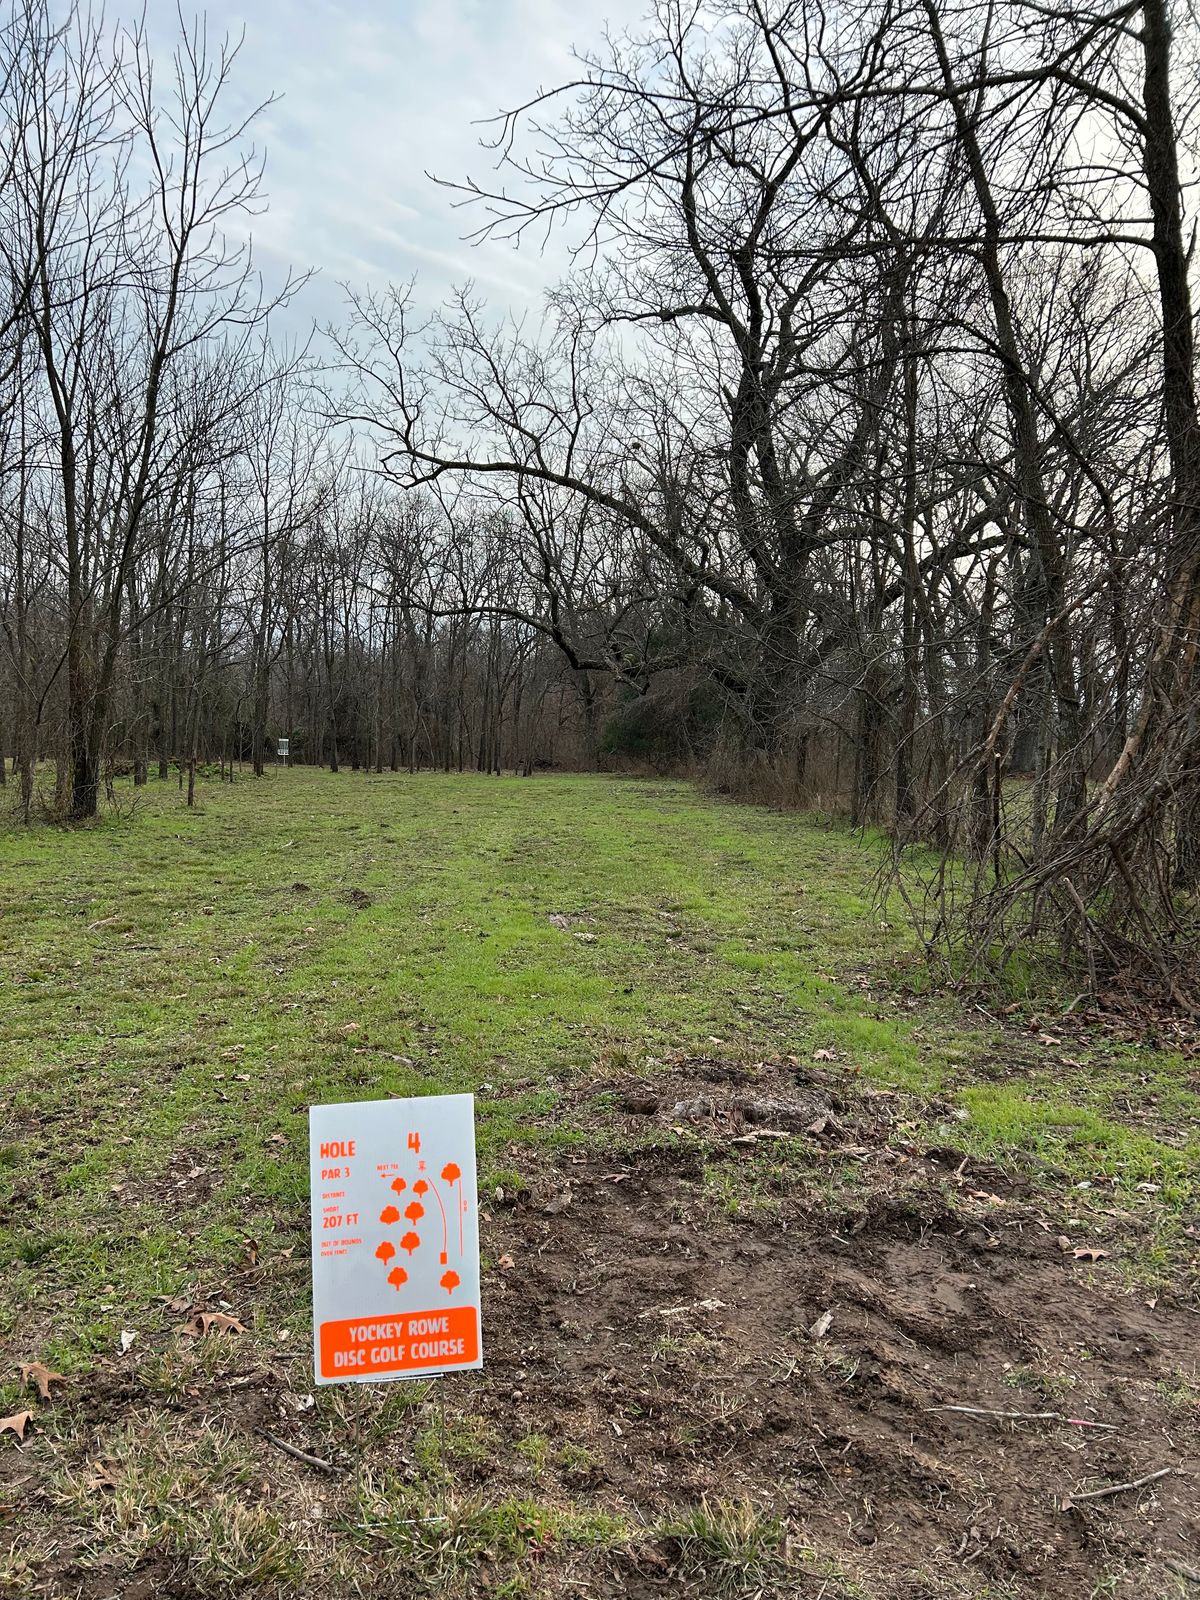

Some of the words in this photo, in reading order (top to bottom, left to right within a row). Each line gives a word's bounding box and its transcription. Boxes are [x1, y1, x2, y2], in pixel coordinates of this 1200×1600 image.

[320, 1141, 356, 1159] HOLE
[408, 1132, 420, 1153] 4
[321, 1168, 341, 1180] PAR
[344, 1167, 351, 1178] 3
[323, 1215, 343, 1229] 207
[346, 1213, 359, 1226] FT
[349, 1322, 403, 1343] YOCKEY
[408, 1317, 449, 1336] ROWE
[334, 1350, 365, 1368] DISC
[370, 1345, 405, 1364] GOLF
[410, 1338, 465, 1359] COURSE
